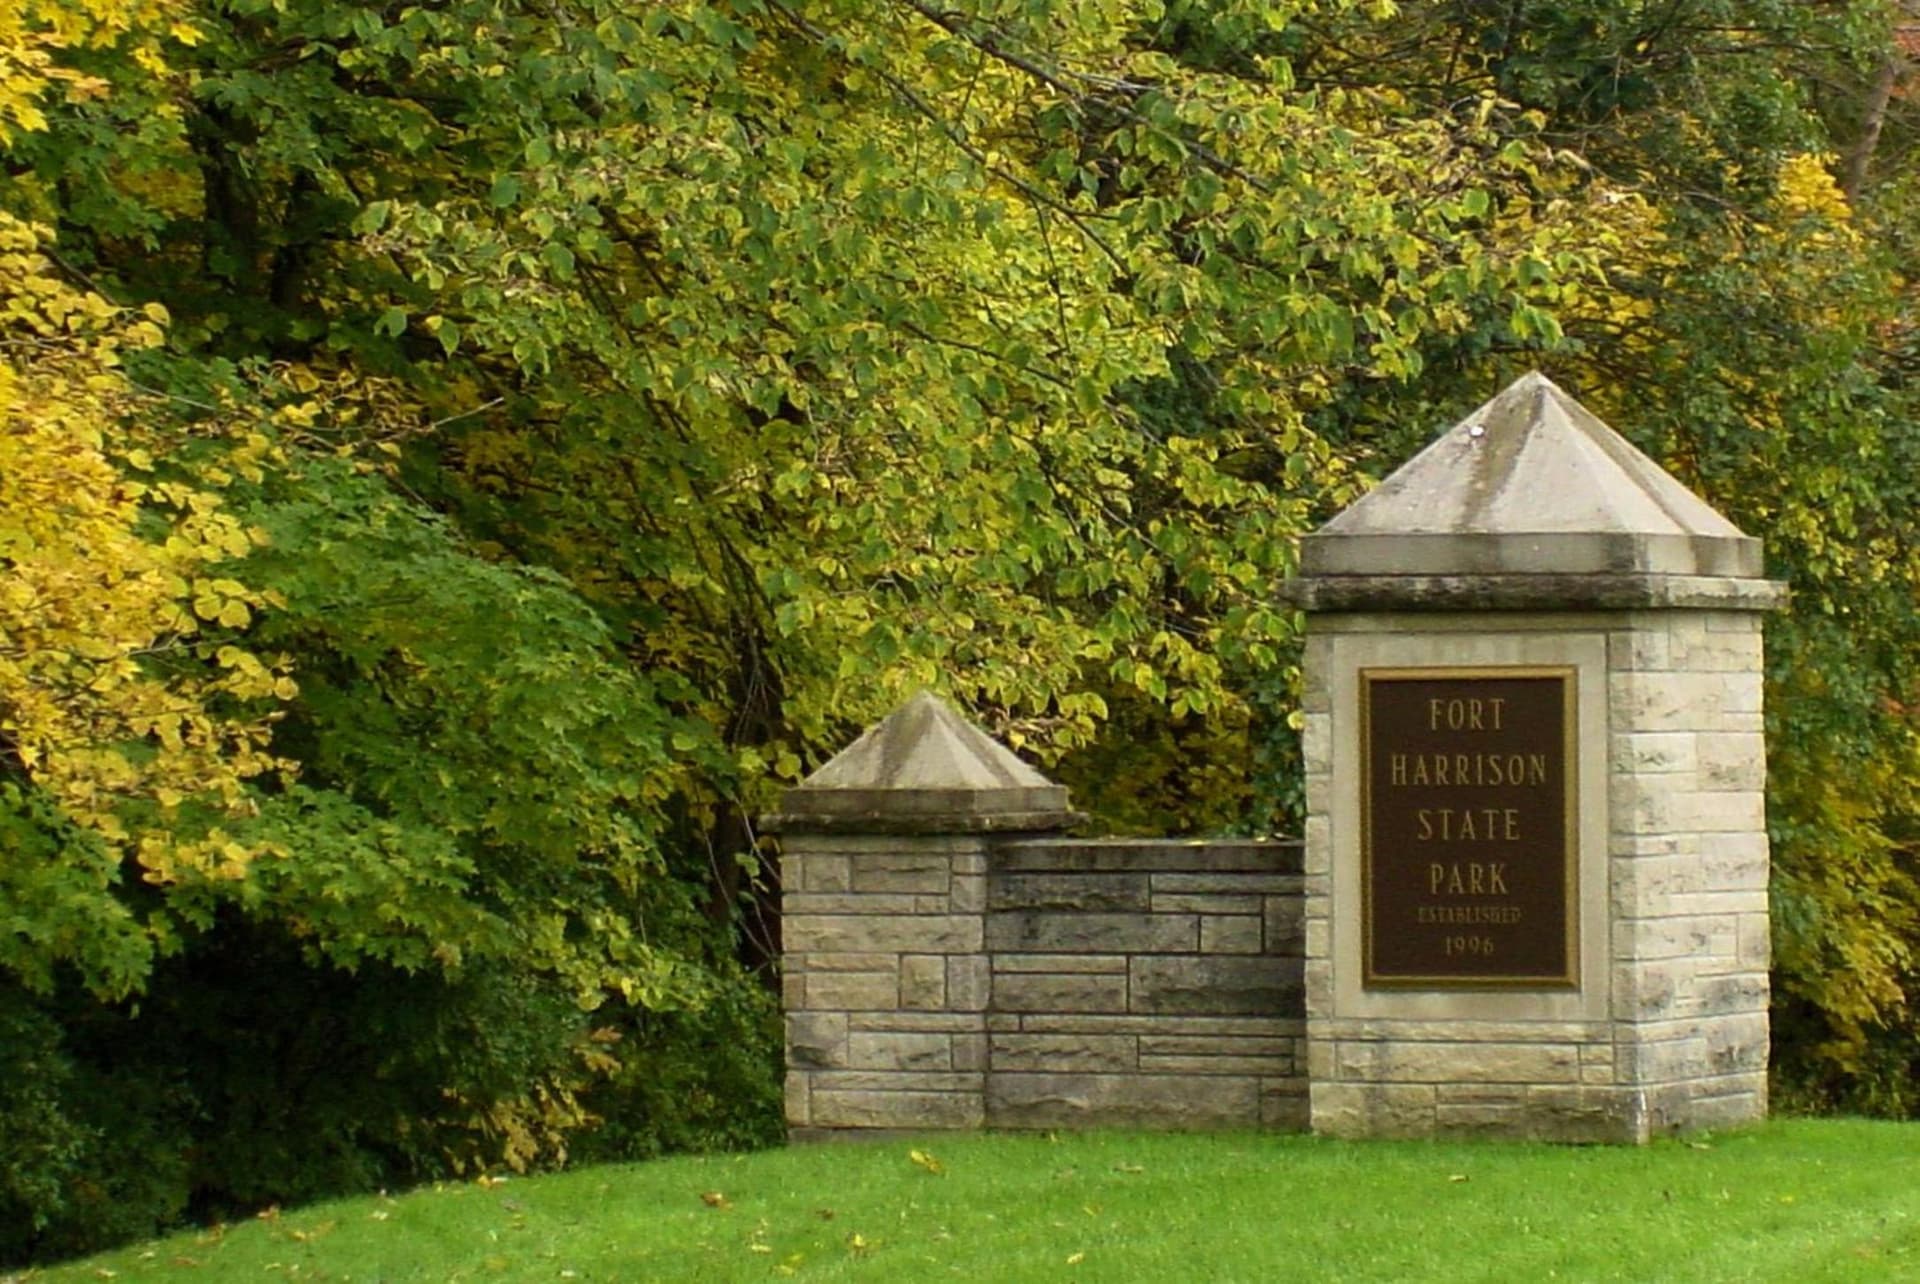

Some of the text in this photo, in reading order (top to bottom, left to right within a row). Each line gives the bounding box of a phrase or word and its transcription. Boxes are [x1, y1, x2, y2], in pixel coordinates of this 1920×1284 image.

[1430, 698, 1505, 731] FORT
[1391, 754, 1546, 786] HARRISON
[1417, 809, 1520, 841] STATE
[1430, 863, 1509, 895] PARK
[1417, 906, 1522, 925] ESTABLISHED
[1445, 936, 1495, 955] 1996
